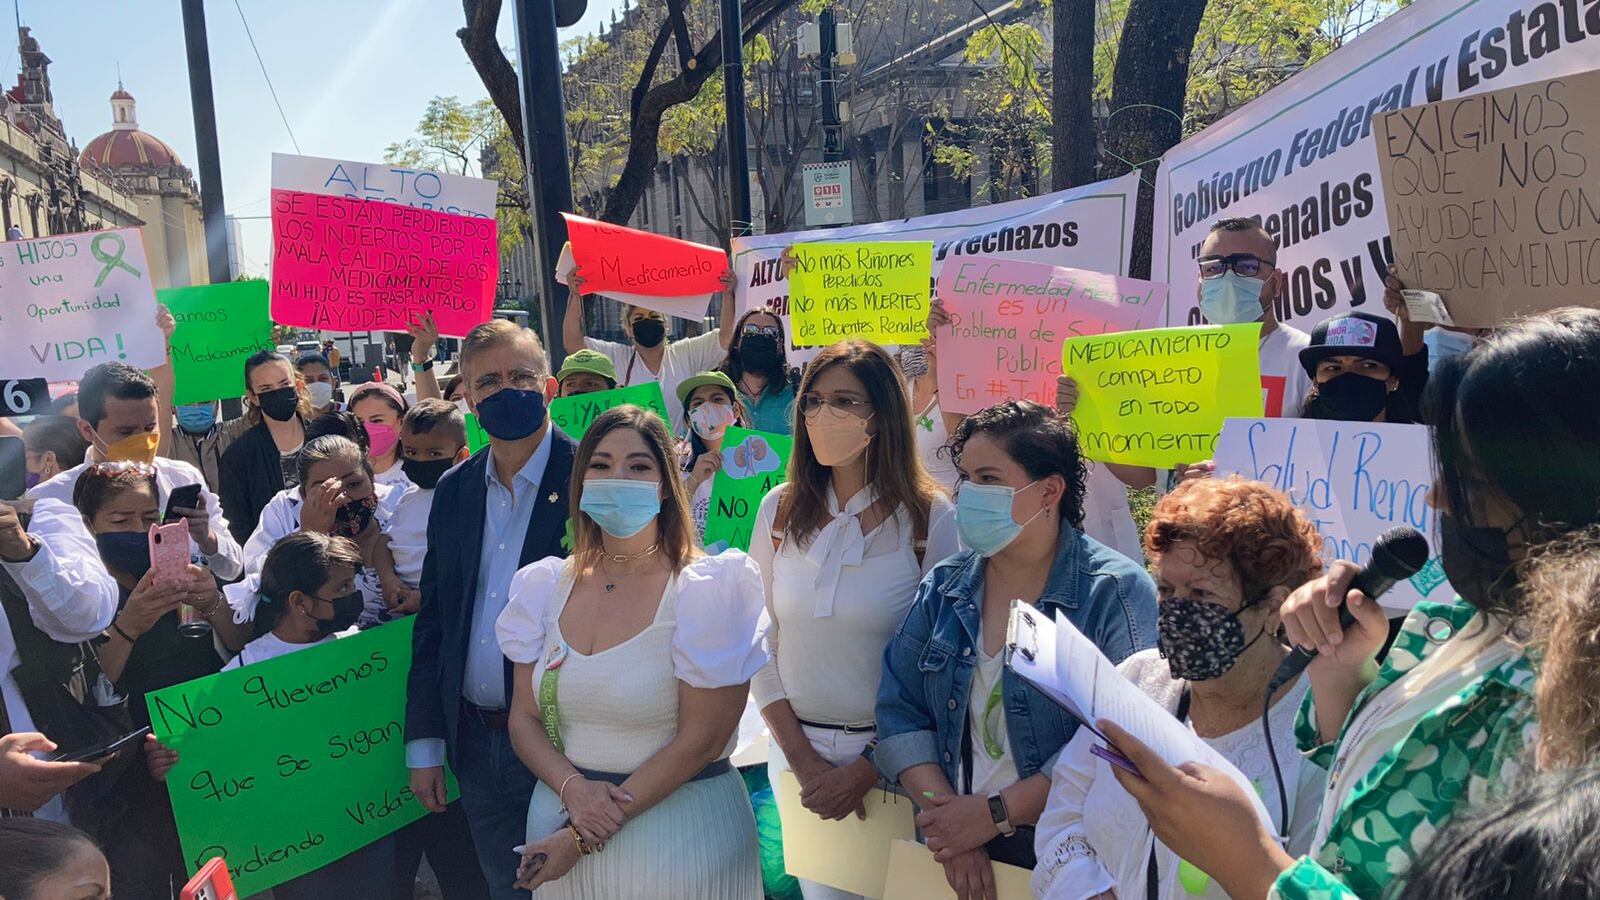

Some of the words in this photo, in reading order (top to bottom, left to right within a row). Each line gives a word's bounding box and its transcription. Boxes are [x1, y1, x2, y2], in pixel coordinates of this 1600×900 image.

[1384, 80, 1570, 157] EXIGIMOS
[1173, 157, 1279, 237] Gobierno
[1283, 64, 1421, 178] Federal
[1391, 149, 1463, 197] QUE
[1499, 129, 1587, 188] NOS
[324, 163, 442, 199] ALTO
[814, 185, 841, 195] 911
[275, 191, 307, 217] SE
[392, 205, 491, 240] PERDIENDO
[1251, 172, 1374, 250] enales
[1396, 195, 1518, 248] AYUDEN
[1535, 186, 1600, 235] CON
[16, 239, 79, 266] HIJOS
[278, 218, 315, 241] LOS
[323, 224, 424, 253] INJERTOS
[430, 235, 466, 256] POR
[472, 243, 493, 260] LA
[954, 221, 1079, 256] rechazos
[278, 241, 332, 265] MALA
[337, 249, 423, 274] CALIDAD
[427, 257, 449, 276] DE
[456, 262, 489, 281] LOS
[600, 255, 713, 288] Medicamento
[794, 251, 816, 274] No
[856, 247, 915, 270] Riñones
[278, 280, 298, 298] MI
[303, 284, 341, 303] HIJO
[347, 289, 367, 307] ES
[371, 289, 476, 312] TRASPLANTADO
[329, 266, 464, 294] MEDICAMENTOS
[953, 262, 1073, 298] Enfermedad
[1079, 284, 1155, 306] Renal
[26, 293, 121, 322] Oportunidad
[863, 290, 923, 312] MUERTES
[997, 299, 1024, 316] es
[799, 319, 817, 338] de
[822, 317, 875, 337] Pacientes
[879, 315, 929, 334] Renales
[950, 312, 1017, 339] Problema
[1028, 318, 1056, 343] de
[3, 379, 31, 414] 6
[955, 374, 976, 400] En
[983, 379, 1057, 403] #Jali
[1148, 400, 1201, 416] TODO
[1352, 431, 1431, 534] Rena
[717, 495, 749, 519] NO
[154, 693, 223, 736] No
